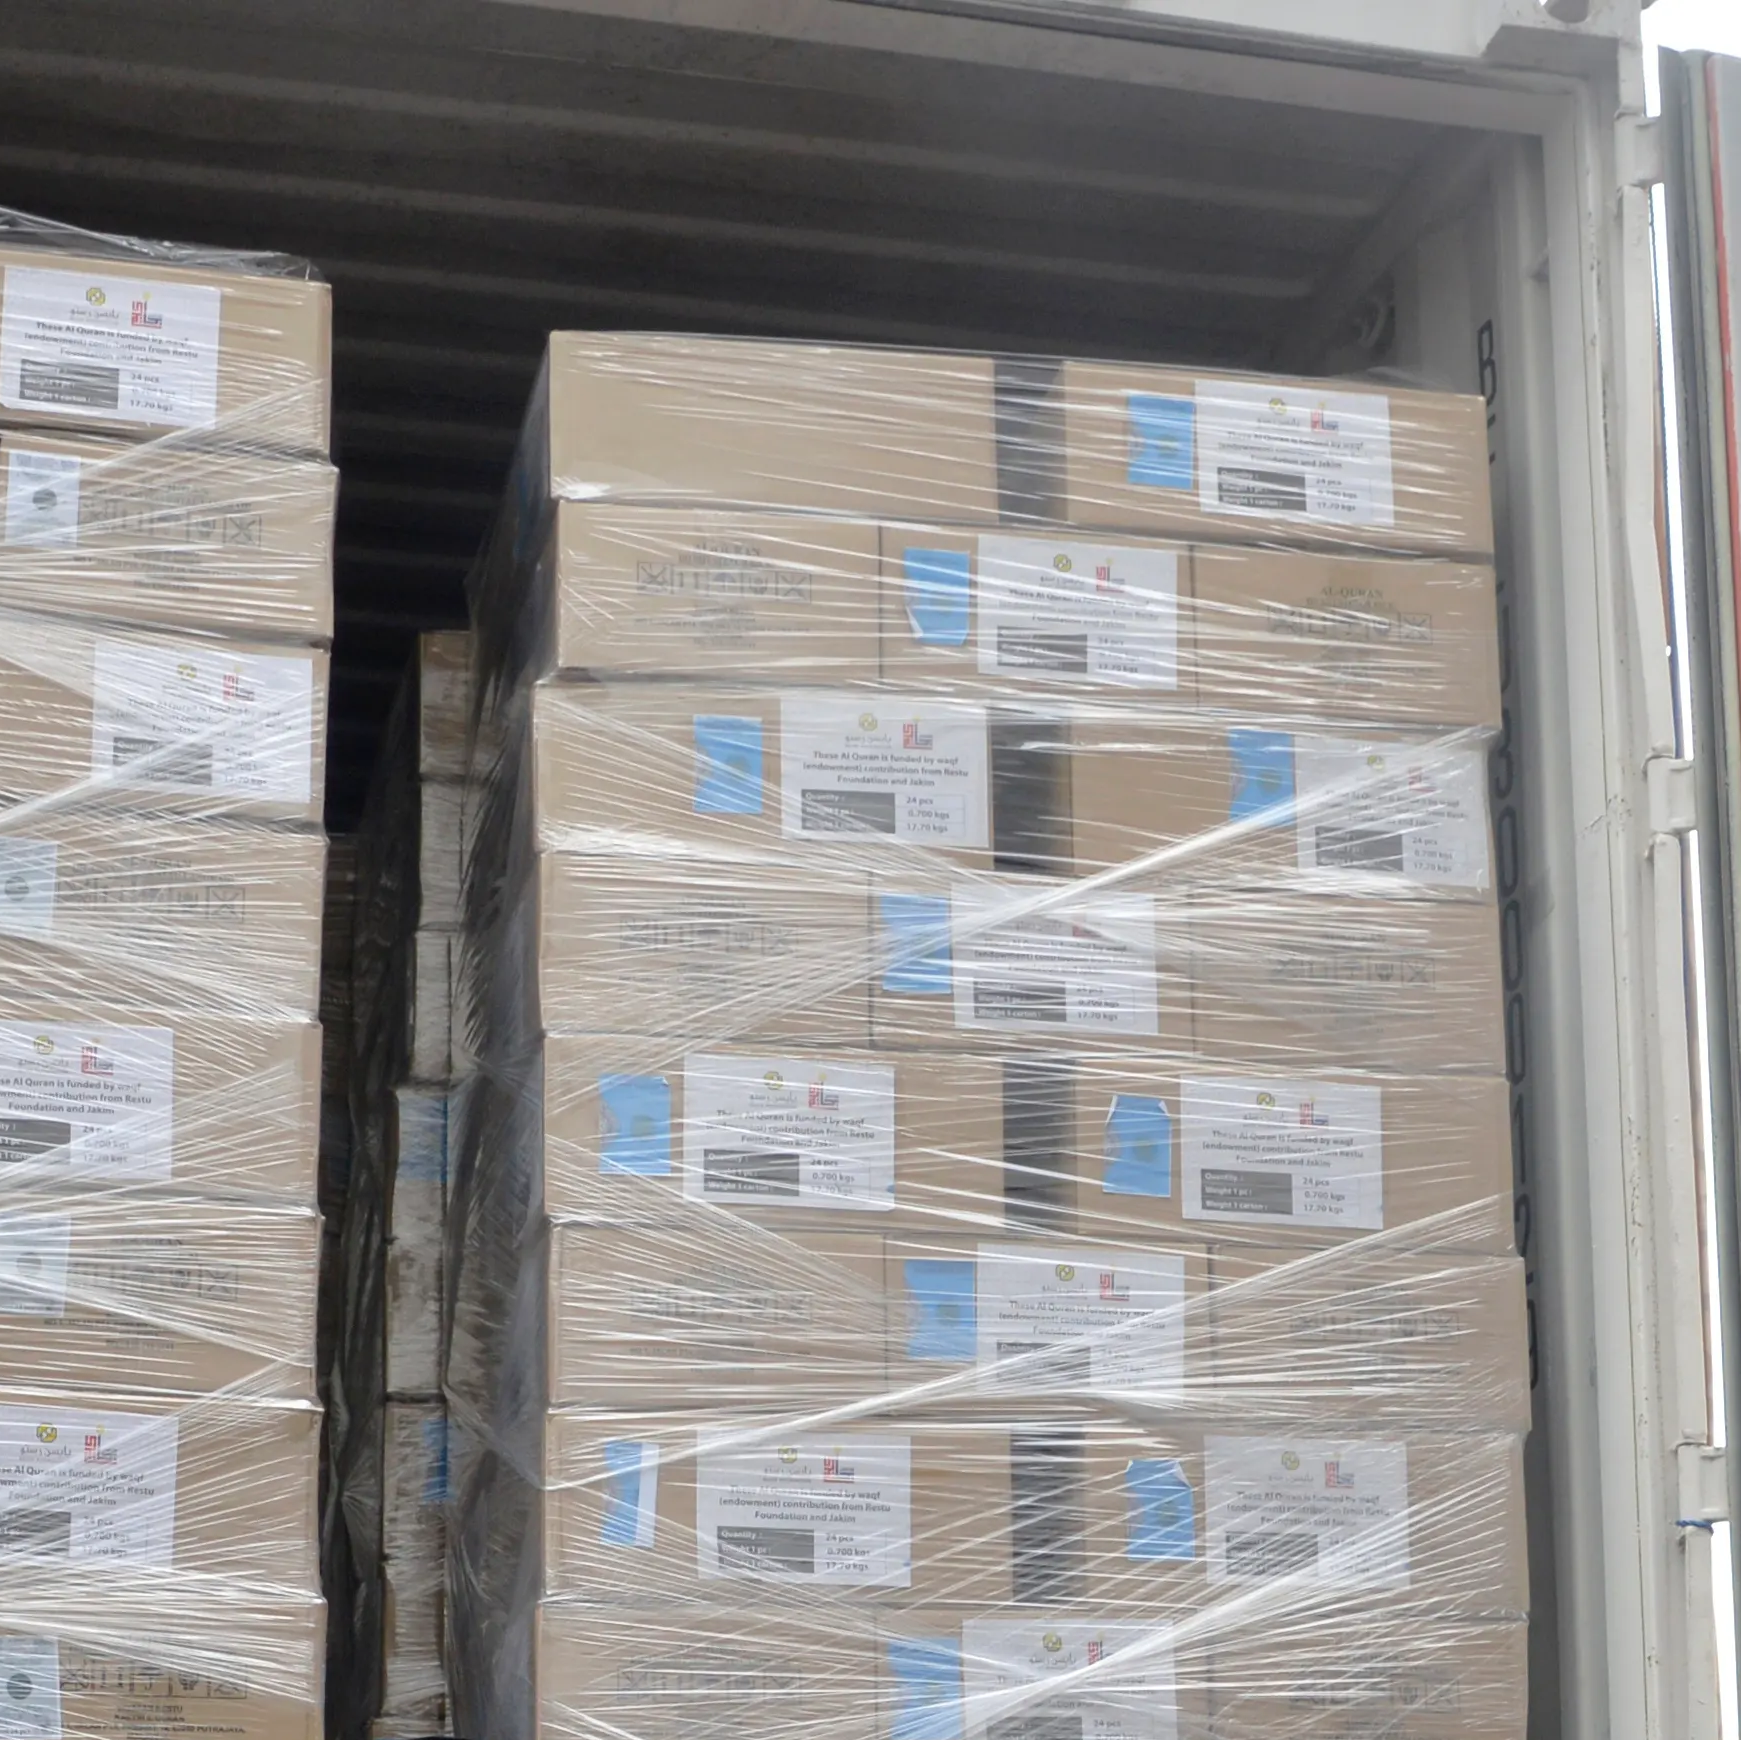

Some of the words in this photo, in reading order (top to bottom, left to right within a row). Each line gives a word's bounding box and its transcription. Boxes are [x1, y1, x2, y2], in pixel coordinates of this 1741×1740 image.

[890, 754, 921, 762] funded
[837, 774, 888, 784] Foundation
[24, 1078, 54, 1087] Quran
[100, 1093, 122, 1102] from
[66, 1104, 84, 1112] and
[783, 1499, 839, 1509] contribution
[841, 1502, 863, 1510] from
[755, 1510, 807, 1520] Foundation
[810, 1513, 826, 1521] and
